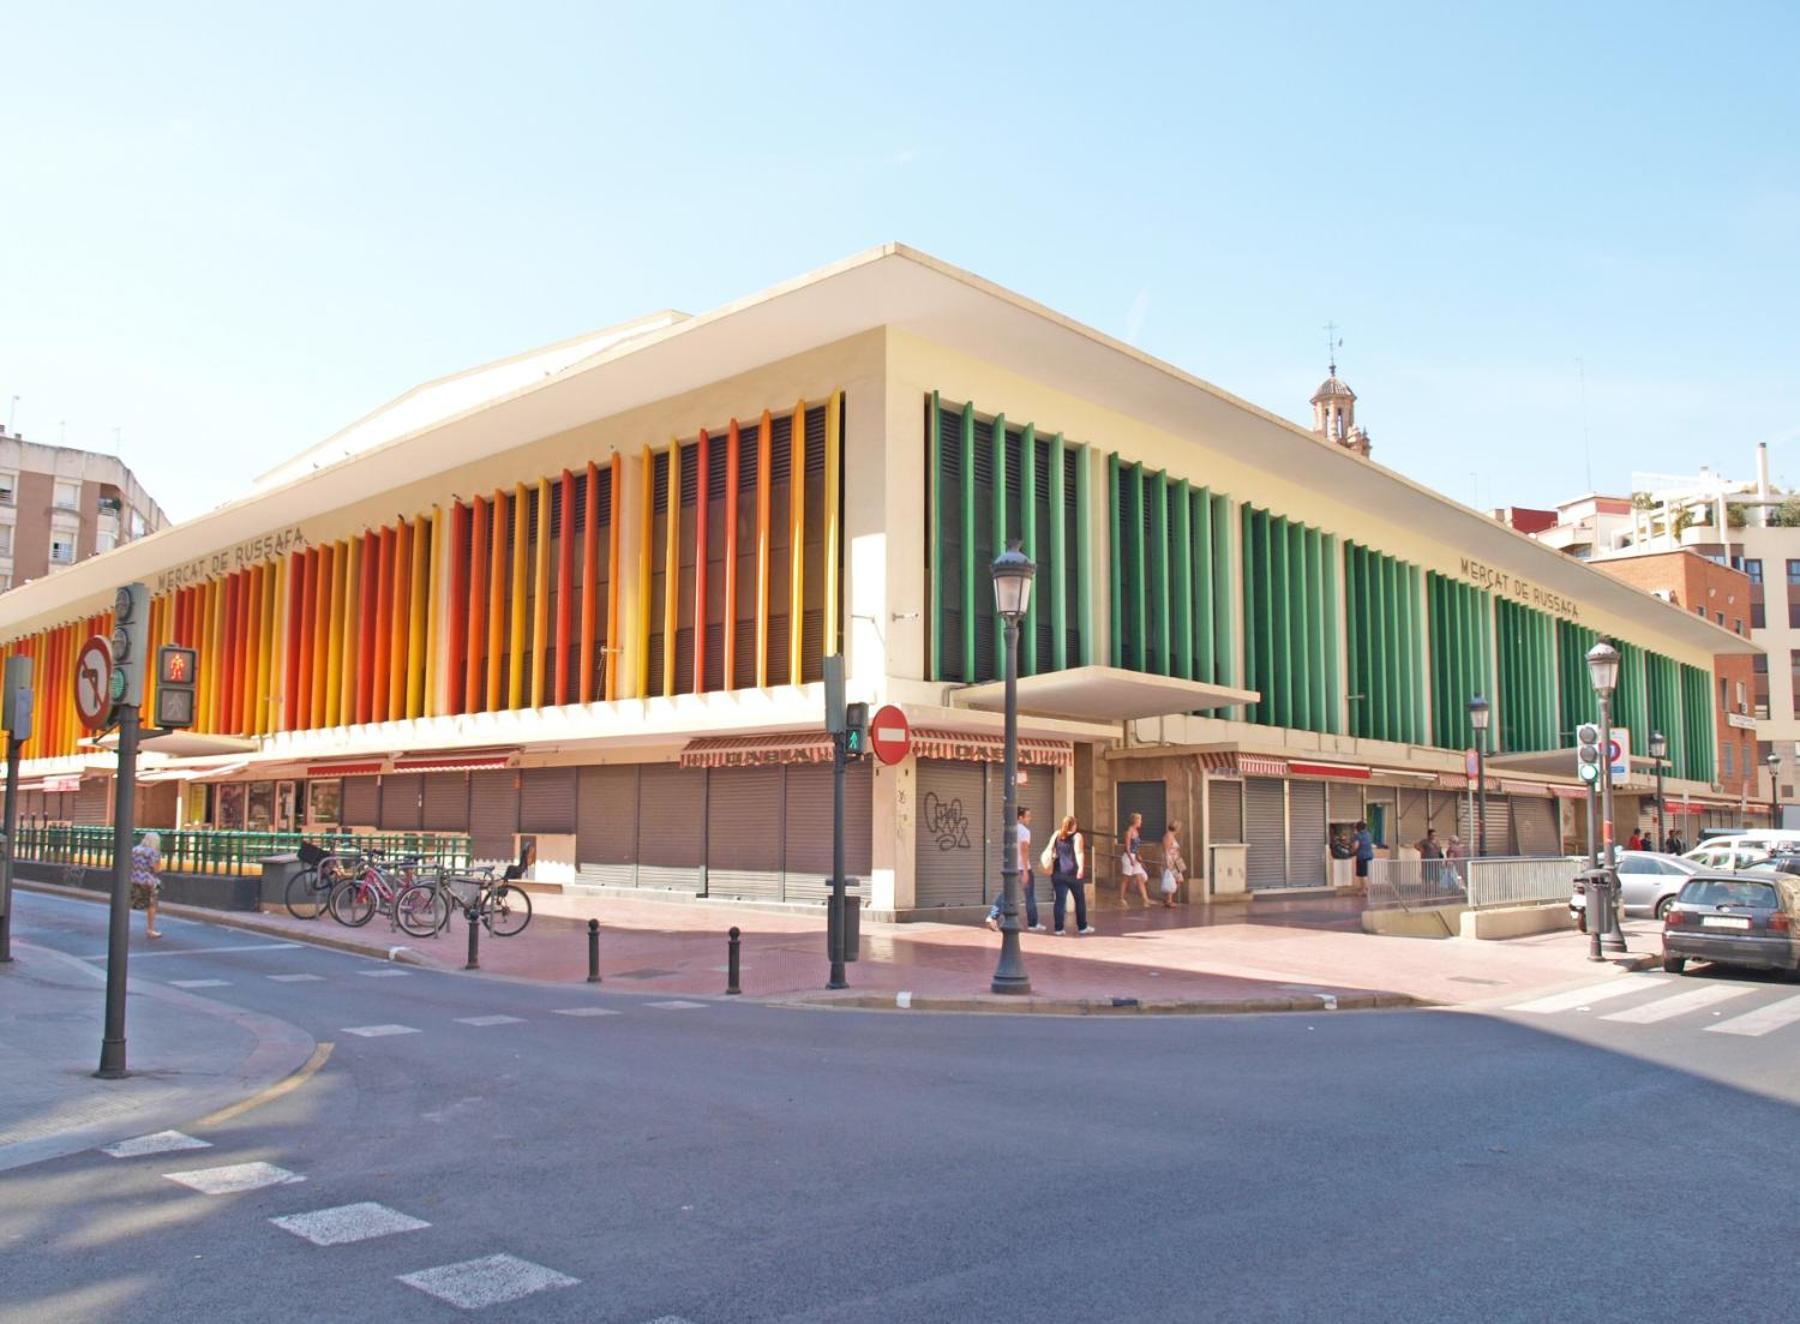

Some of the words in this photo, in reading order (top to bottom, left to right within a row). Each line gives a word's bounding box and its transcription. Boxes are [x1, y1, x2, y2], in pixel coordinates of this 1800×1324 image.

[157, 559, 205, 590] MERCAT
[211, 551, 229, 573] DE
[235, 528, 303, 565] RUSSAFA
[1515, 580, 1529, 600] DE
[1533, 588, 1579, 617] RUSSAFA
